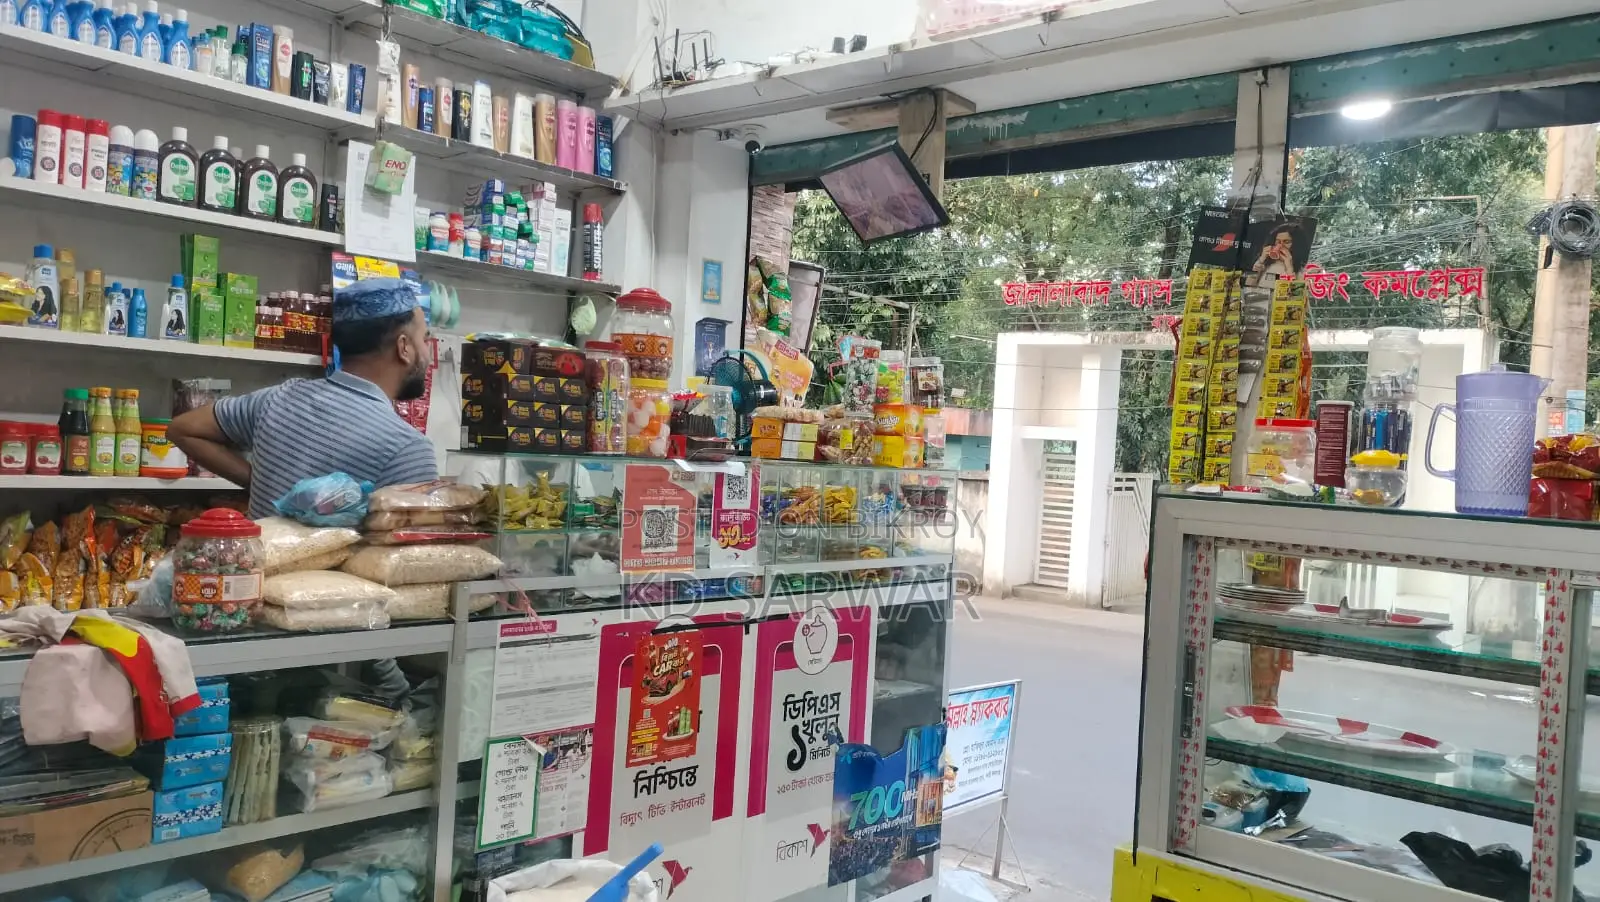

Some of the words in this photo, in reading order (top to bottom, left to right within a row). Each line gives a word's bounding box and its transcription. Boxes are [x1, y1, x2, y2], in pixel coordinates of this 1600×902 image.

[170, 162, 189, 170] Dettol
[385, 160, 407, 171] ENO
[291, 186, 308, 194] Dettol
[1001, 279, 1112, 307] জালালাবাদ
[1121, 275, 1173, 308] গ্যাস
[1280, 263, 1349, 301] জিং
[1362, 266, 1485, 301] কমপ্লেক্স
[783, 691, 841, 721] ডিপিএস
[802, 714, 840, 744] খুলুন
[787, 725, 807, 771] ১
[809, 746, 831, 761] মিনিটে
[633, 765, 699, 798] নিশ্চিন্তে
[648, 804, 666, 819] টিভি
[670, 793, 706, 812] ইন্টারনেট
[848, 780, 906, 830] 700
[776, 838, 808, 862] বিকাশ
